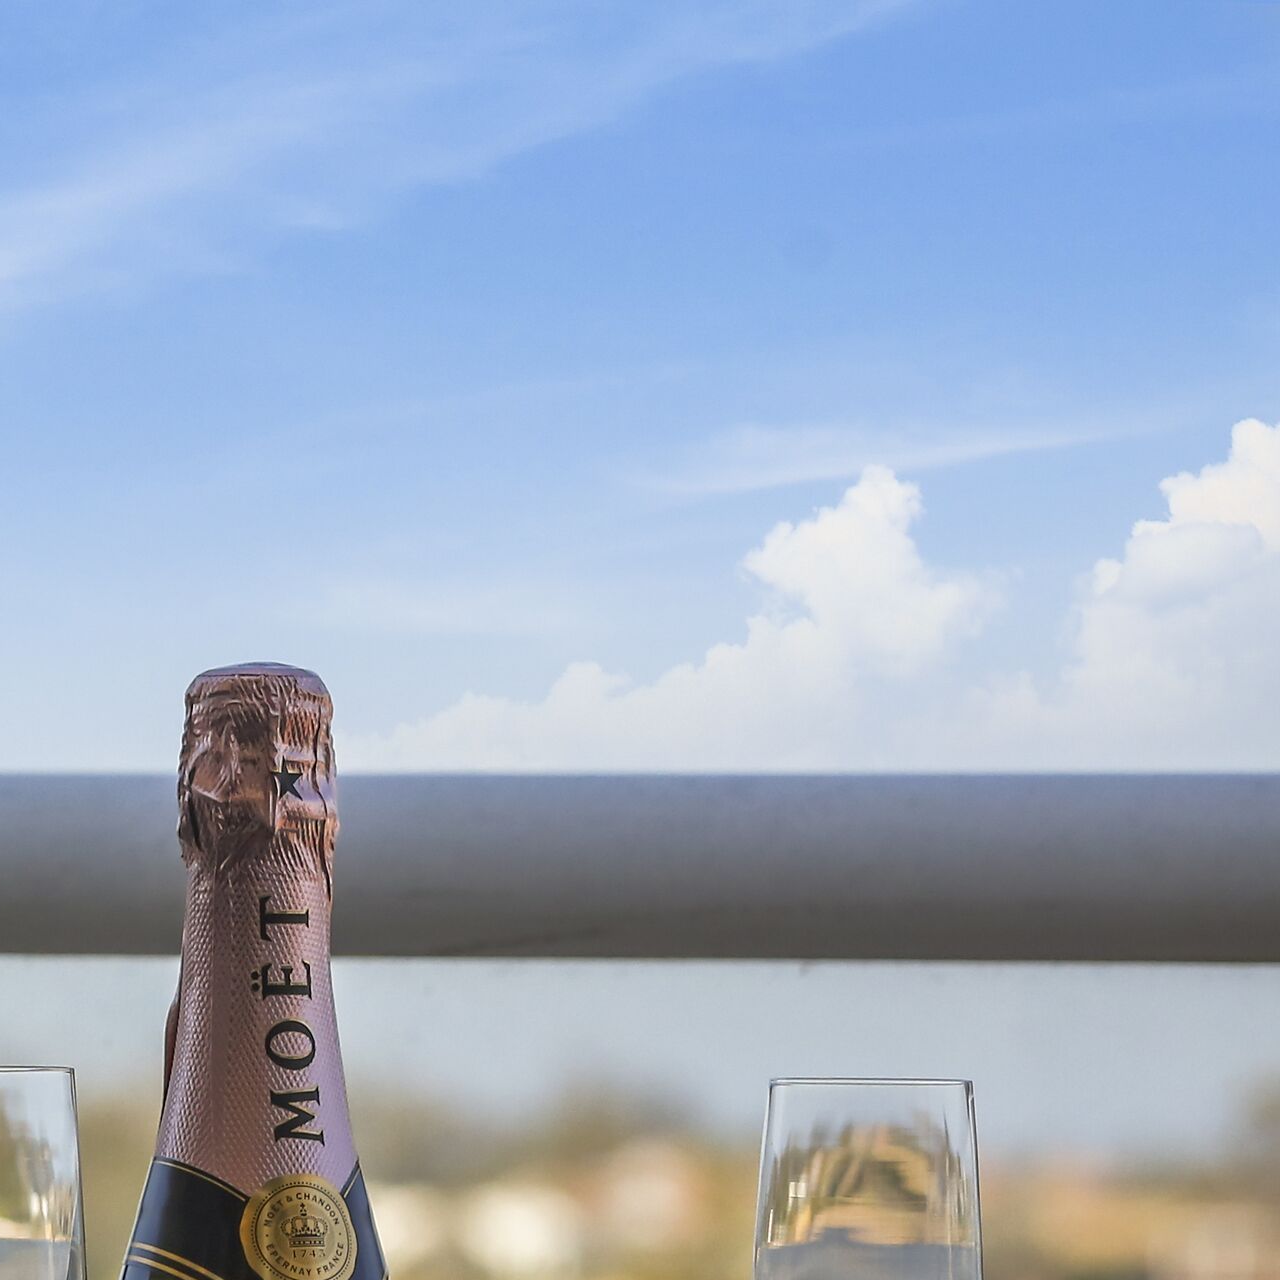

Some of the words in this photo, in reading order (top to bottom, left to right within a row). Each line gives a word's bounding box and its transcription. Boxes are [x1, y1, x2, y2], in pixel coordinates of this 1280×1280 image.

[251, 896, 325, 1147] MOËT
[296, 1192, 340, 1225] CHANDON
[316, 1242, 344, 1275] FRANCE
